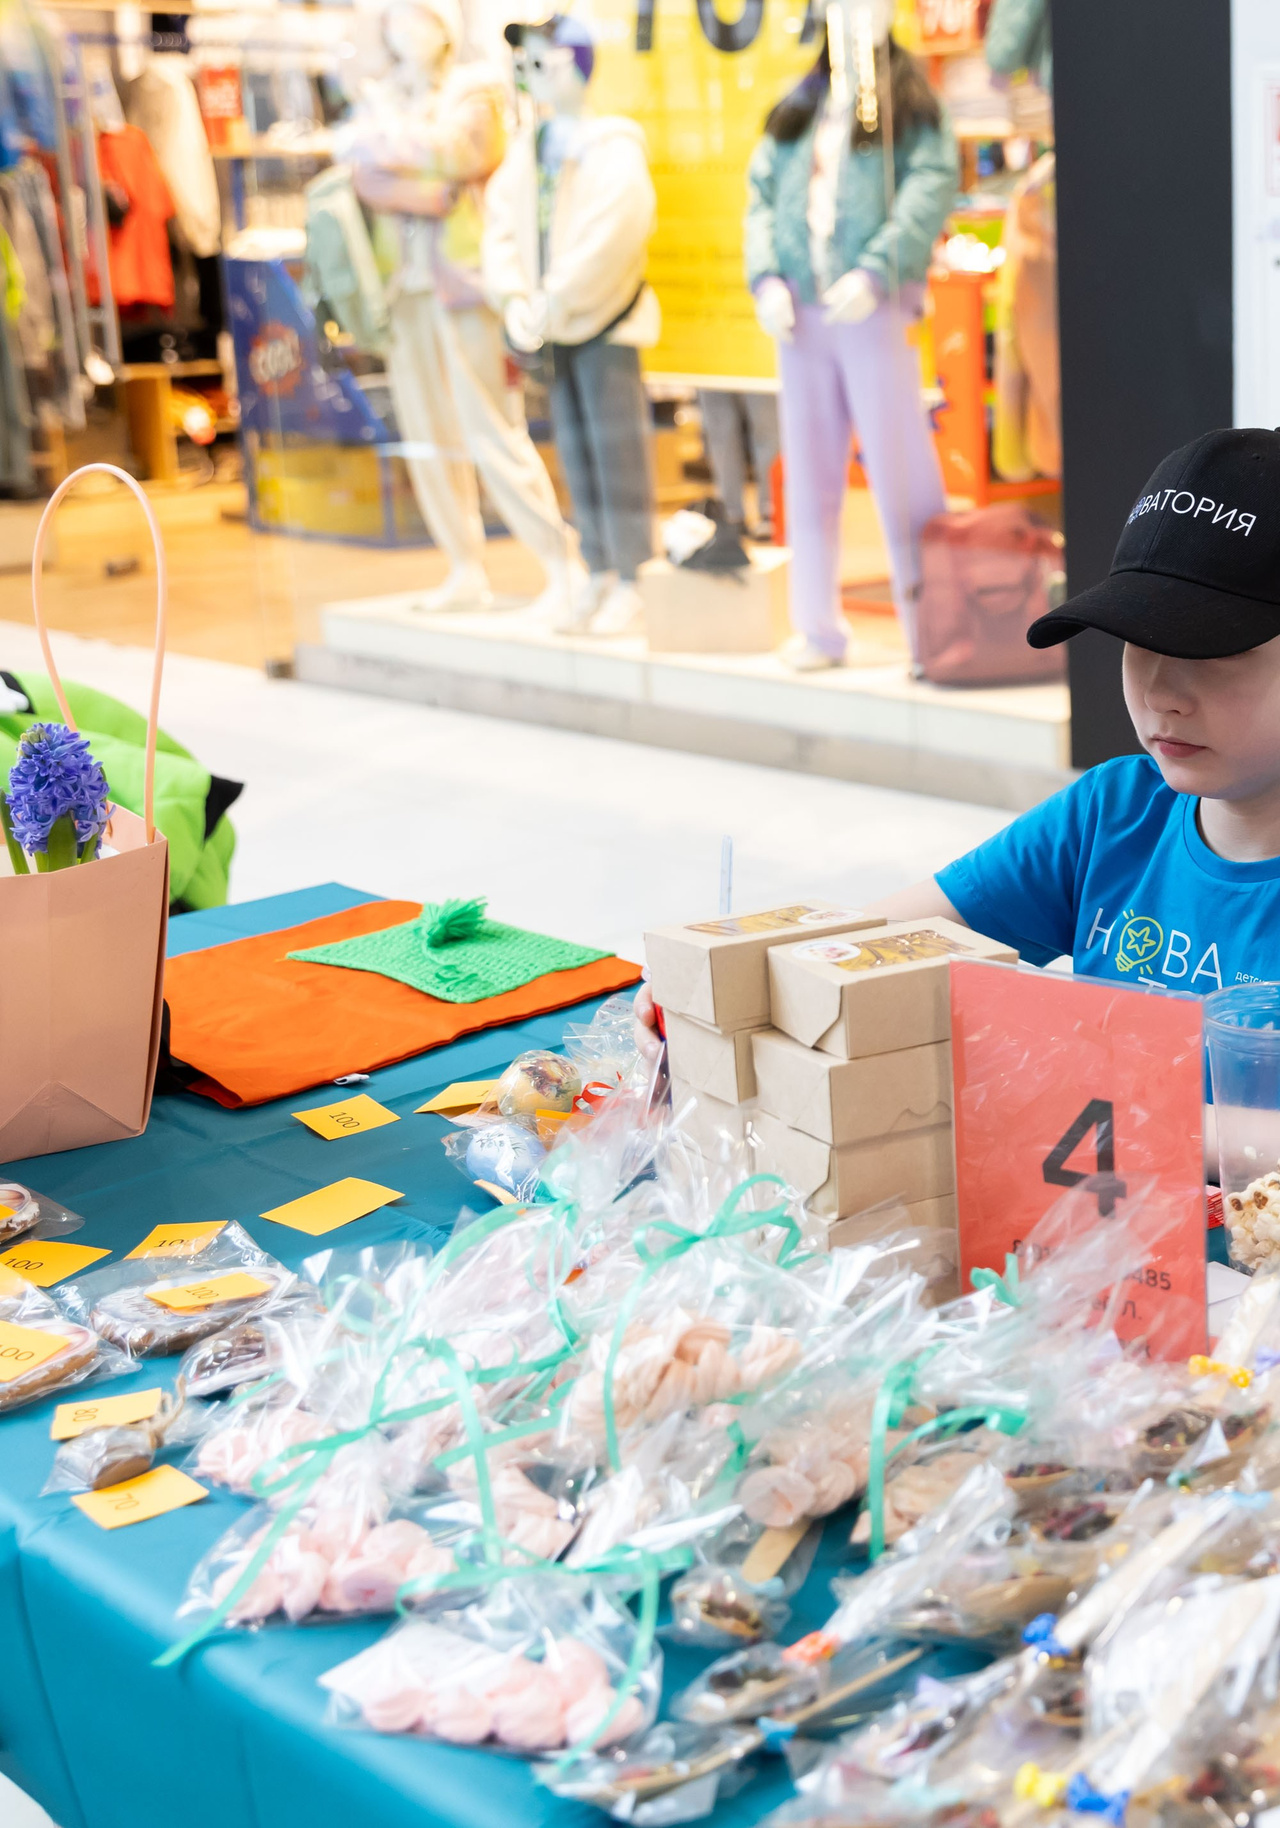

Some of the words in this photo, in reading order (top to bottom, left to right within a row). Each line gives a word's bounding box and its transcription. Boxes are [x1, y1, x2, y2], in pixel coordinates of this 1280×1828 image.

[328, 1111, 361, 1129] 100
[1042, 1098, 1127, 1219] 4
[3, 1257, 44, 1272] 100
[184, 1286, 219, 1300] 100
[0, 1343, 35, 1362] 00
[73, 1407, 98, 1422] 80
